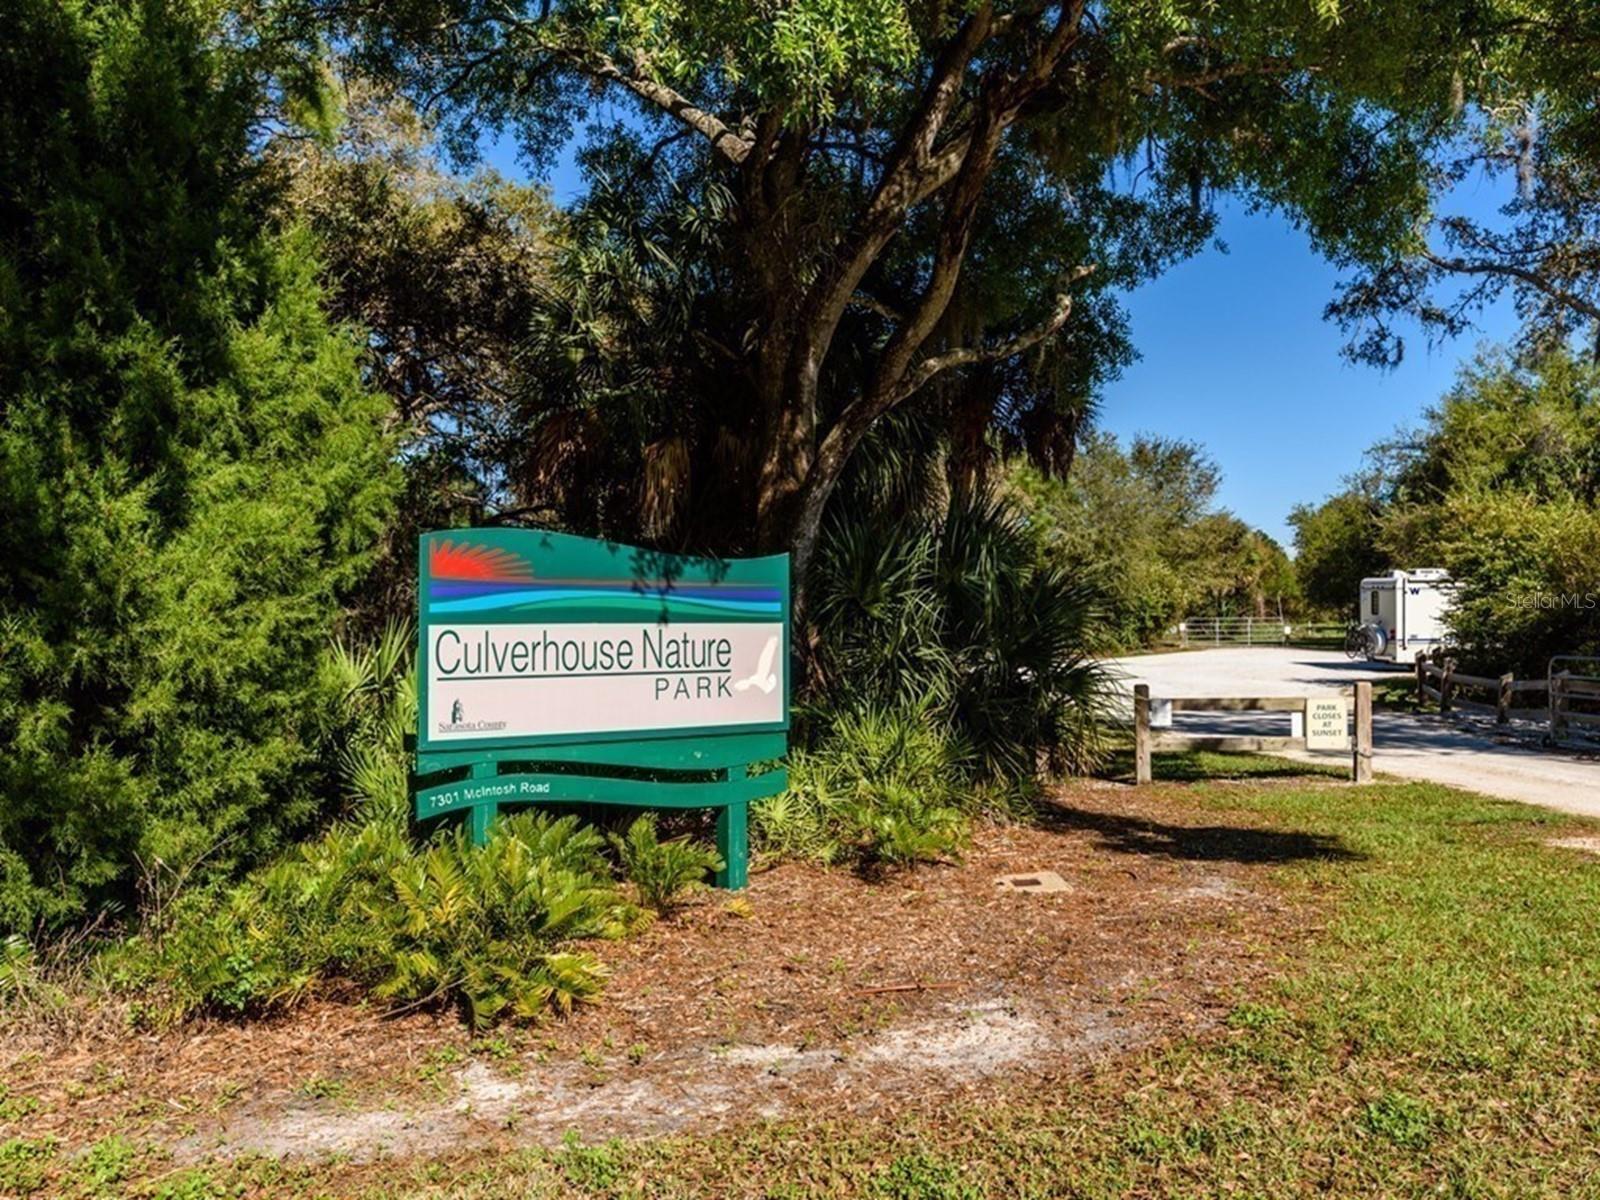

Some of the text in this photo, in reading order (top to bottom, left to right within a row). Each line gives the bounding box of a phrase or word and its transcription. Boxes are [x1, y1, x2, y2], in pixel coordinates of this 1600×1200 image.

[435, 629, 732, 674] Culverhouse Nature
[655, 675, 733, 700] PARK
[1312, 712, 1342, 720] CLOSES
[1312, 729, 1342, 737] SUNSET
[429, 781, 551, 808] 7301 McIntosh Road
